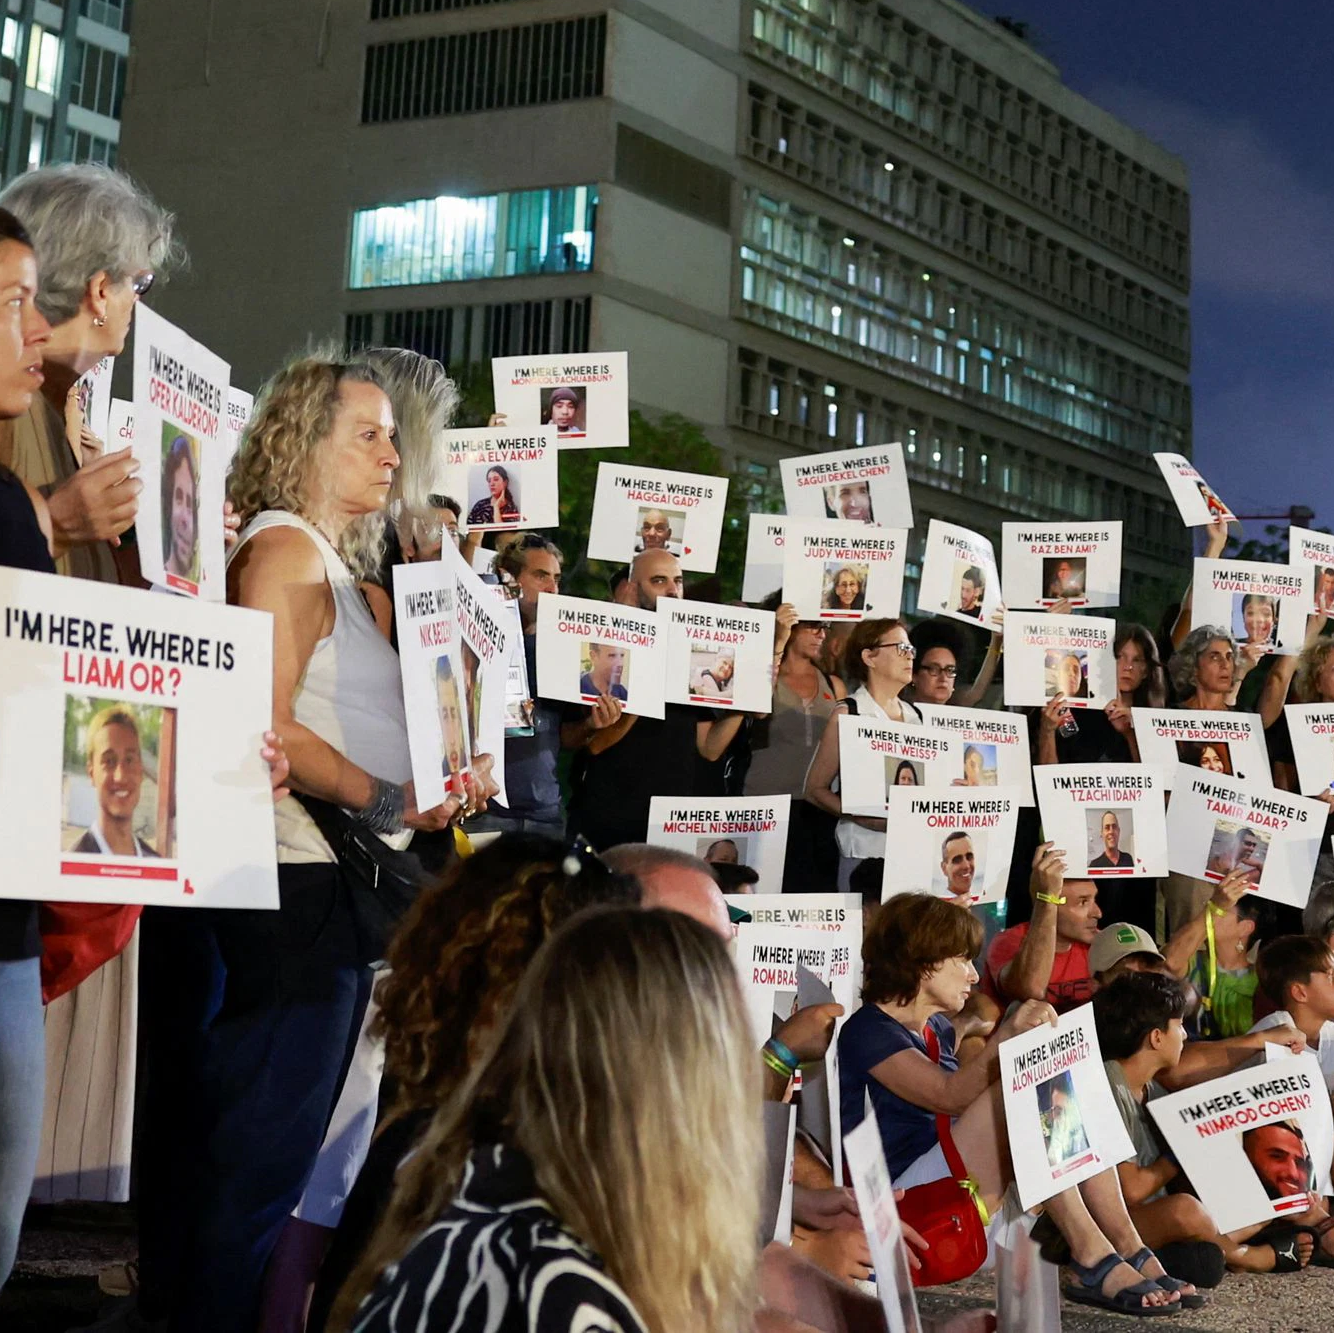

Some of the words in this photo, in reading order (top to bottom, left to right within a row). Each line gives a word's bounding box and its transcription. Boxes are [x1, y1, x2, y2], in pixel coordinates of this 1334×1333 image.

[149, 345, 163, 381] I'M
[186, 368, 215, 408] WHERE
[213, 387, 221, 414] IS
[149, 377, 171, 414] OFER
[171, 393, 218, 441] KALDERON?
[796, 467, 811, 477] I'M
[842, 458, 877, 471] WHERE
[879, 455, 889, 464] IS
[615, 477, 630, 489] I'M
[667, 483, 703, 497] WHERE
[704, 487, 713, 498] IS
[627, 490, 670, 505] HAGGAI
[673, 495, 699, 508] GAD?
[804, 536, 819, 547] I'M
[851, 539, 886, 550] WHERE
[886, 540, 895, 550] IS
[1018, 533, 1033, 542] I'M
[1065, 533, 1100, 542] WHERE
[1101, 532, 1109, 541] IS
[804, 548, 832, 558] JUDY
[834, 549, 893, 561] WEINSTEIN?
[1031, 545, 1052, 554] RAZ
[1054, 545, 1074, 554] BEN
[1075, 545, 1097, 553] AMI?
[558, 609, 575, 622] I'M
[612, 617, 647, 634] WHERE
[647, 623, 656, 636] IS
[671, 611, 686, 624] I'M
[715, 617, 750, 632] WHERE
[750, 621, 759, 633] IS
[5, 607, 42, 642] I'M
[49, 614, 118, 653] HERE.
[126, 625, 209, 667] WHERE
[216, 640, 235, 671] IS
[558, 622, 591, 636] OHAD
[594, 627, 654, 648] YAHALOMI?
[686, 626, 711, 640] YAFA
[713, 630, 745, 644] ADAR?
[63, 652, 124, 690] LIAM
[130, 662, 181, 697] OR?
[1152, 718, 1169, 728] I'M
[1200, 721, 1241, 731] WHERE
[1242, 723, 1251, 732] IS
[1305, 714, 1321, 723] I'M
[858, 728, 874, 739] I'M
[903, 735, 939, 749] WHERE
[939, 742, 948, 751] IS
[1156, 728, 1184, 738] OFRY
[1187, 730, 1249, 741] BRODUTCH?
[871, 740, 897, 752] SHIRI
[900, 745, 937, 761] WEISS?
[1053, 777, 1072, 789] I'M
[1107, 776, 1144, 788] WHERE
[1144, 776, 1152, 788] IS
[1070, 790, 1113, 801] TZACHI
[1113, 790, 1141, 801] IDAN?
[670, 809, 690, 821] I'M
[725, 809, 764, 821] WHERE
[765, 808, 774, 820] IS
[911, 801, 931, 814] I'M
[969, 801, 1003, 813] WHERE
[1003, 800, 1010, 812] IS
[663, 822, 707, 834] MICHEL
[709, 820, 777, 833] NISENBAUM?
[927, 815, 960, 828] OMRI
[961, 815, 999, 827] MIRAN?
[1179, 1102, 1206, 1124] I'M
[1247, 1079, 1299, 1102] WHERE
[1299, 1074, 1310, 1089] IS
[1195, 1111, 1258, 1138] NIMROD
[1259, 1095, 1312, 1118] COHEN?
